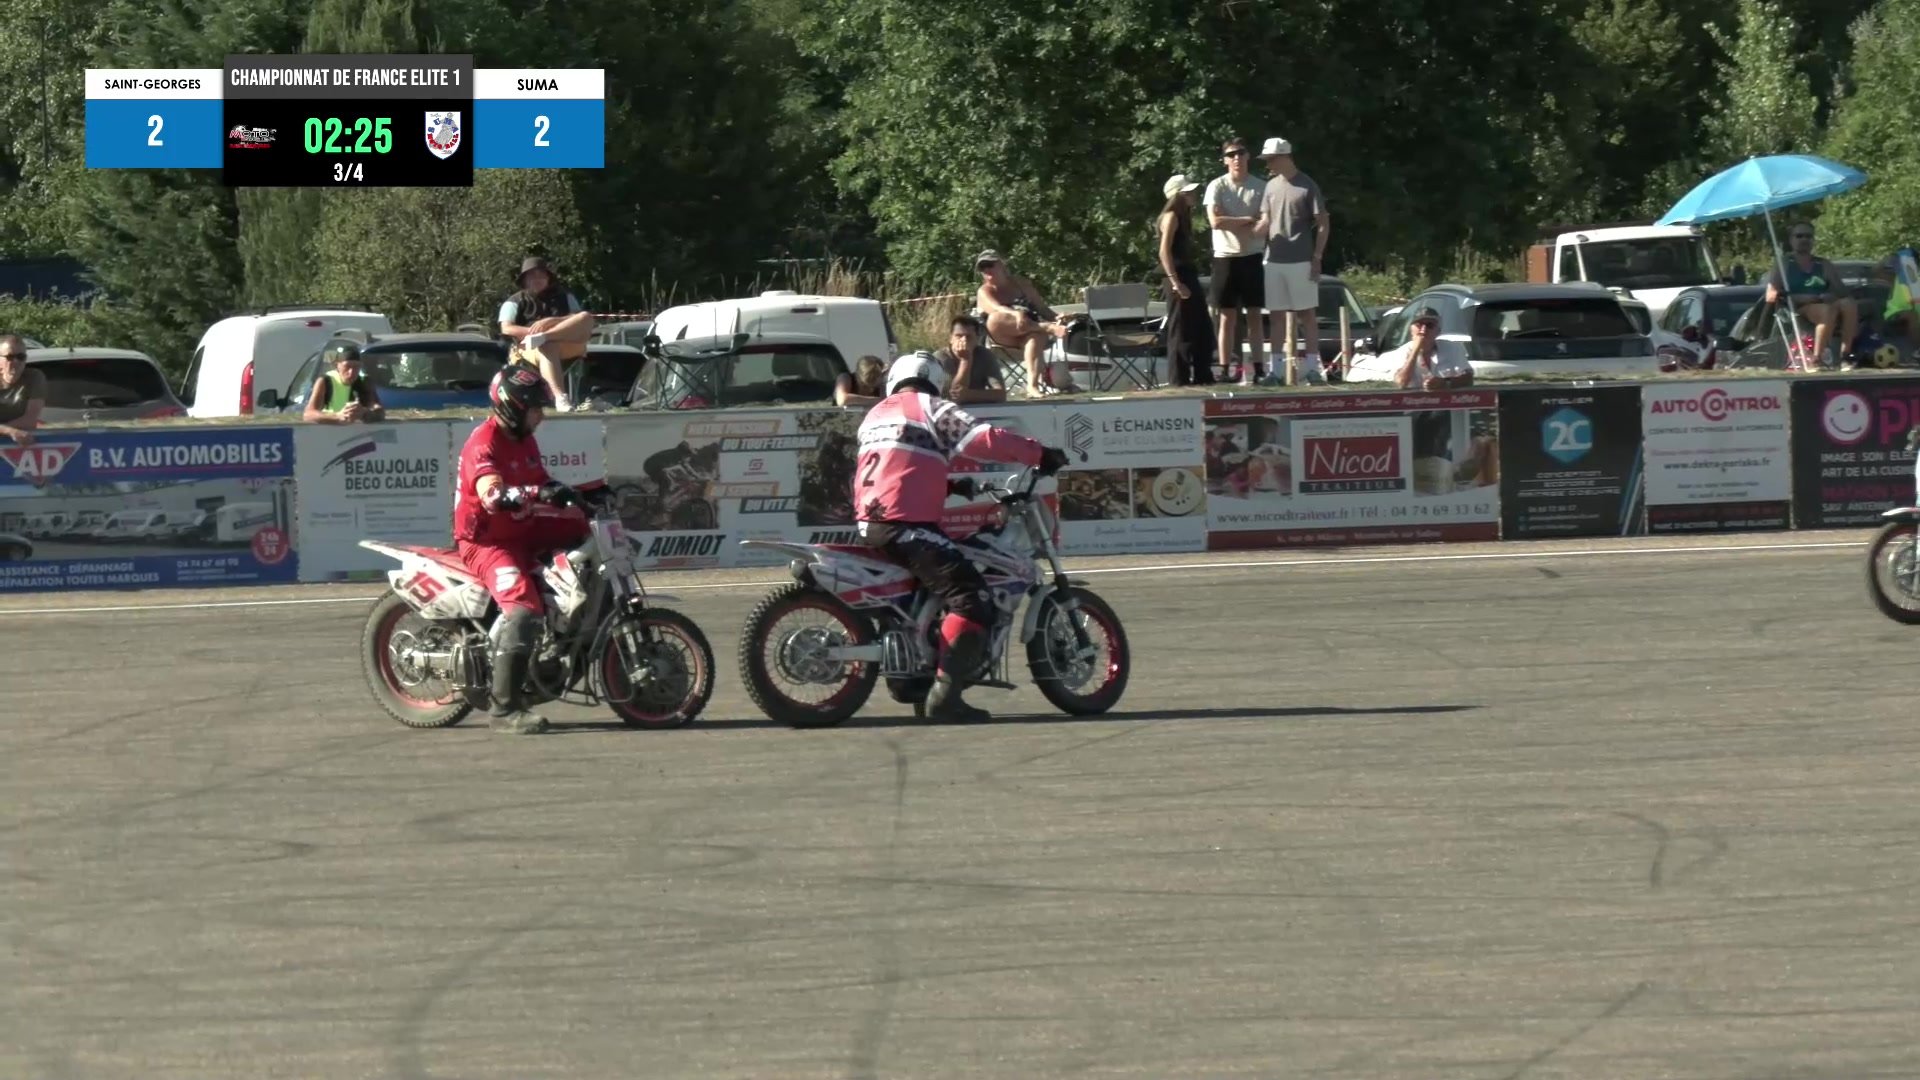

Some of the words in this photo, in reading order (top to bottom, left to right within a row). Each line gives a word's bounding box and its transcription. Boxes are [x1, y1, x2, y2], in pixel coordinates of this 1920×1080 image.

[1541, 397, 1593, 405] ATELIER
[1651, 388, 1781, 421] AUTOCONTROL
[1549, 420, 1592, 450] 2C
[14, 451, 64, 478] AD
[90, 449, 126, 468] B.V.
[133, 443, 282, 467] AUTOMOBILES
[345, 458, 439, 475] BEAUJOLAIS
[1310, 441, 1393, 475] Nicod
[1821, 452, 1857, 463] IMAGE
[1862, 451, 1884, 462] SON
[862, 452, 881, 487] 2
[1822, 467, 1843, 478] ART
[1845, 467, 1860, 477] DE
[1863, 466, 1878, 477] LA
[345, 477, 381, 491] DECO
[385, 475, 437, 489] CALADE
[1310, 481, 1396, 491] TRAITEUR
[1217, 507, 1350, 524] www.nicodtraiteur.fr
[1391, 506, 1408, 518] 04
[1412, 504, 1429, 516] 74
[1432, 503, 1450, 516] 69
[1474, 502, 1491, 515] 62
[646, 534, 726, 557] AUMIOT
[66, 573, 104, 585] TOUTES
[107, 572, 159, 583] MARQUES
[403, 570, 447, 604] 15
